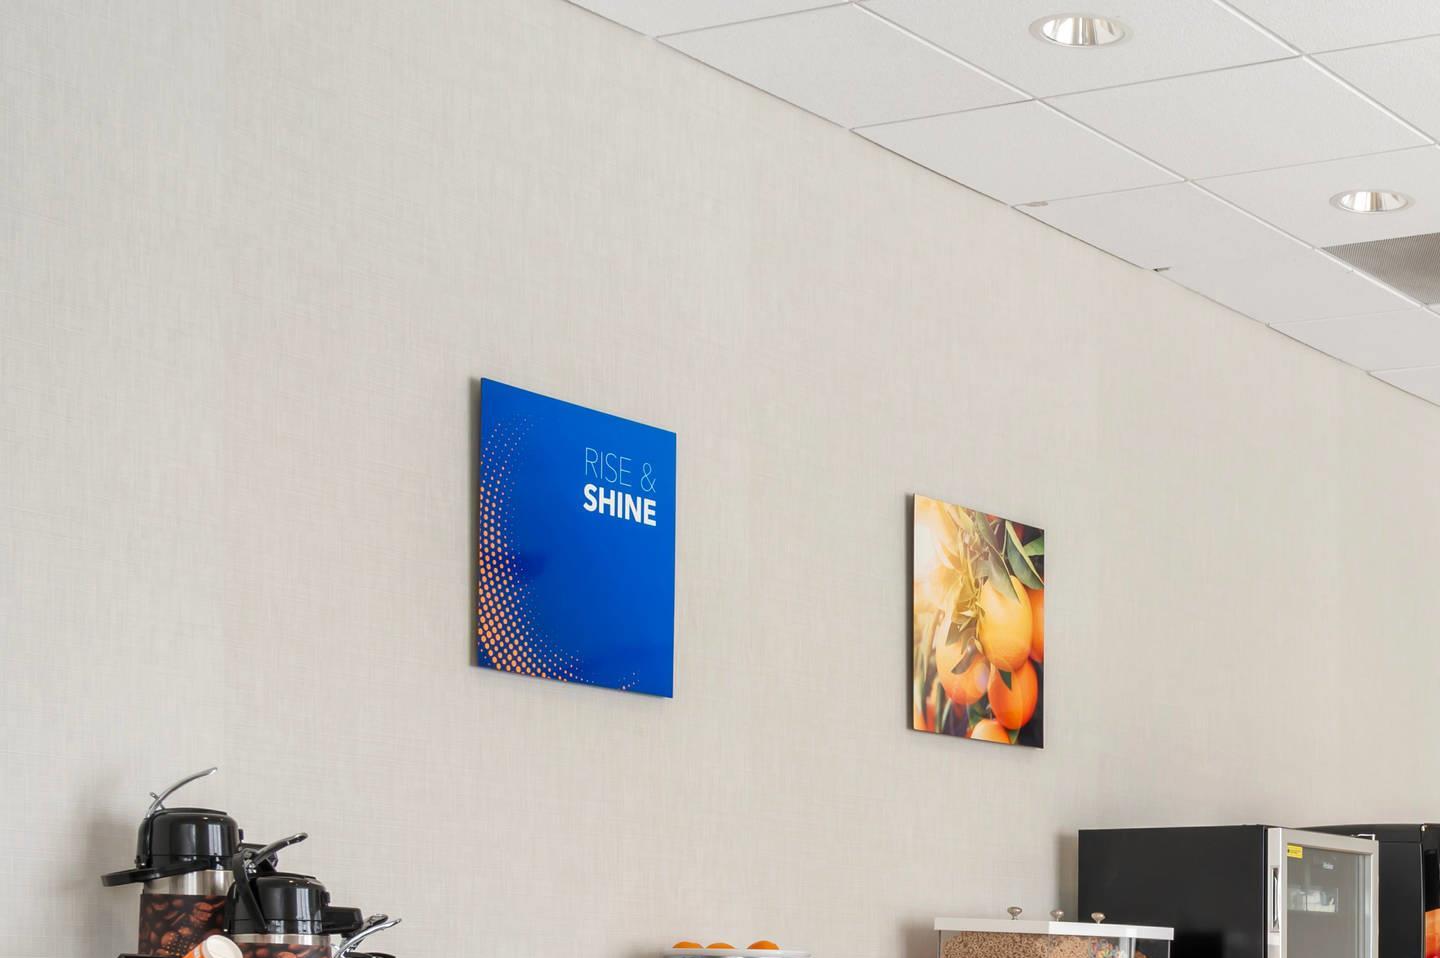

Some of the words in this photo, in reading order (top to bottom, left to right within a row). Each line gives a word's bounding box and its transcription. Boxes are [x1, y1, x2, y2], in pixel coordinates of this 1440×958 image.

[585, 447, 632, 487] RISE
[640, 462, 656, 493] &
[583, 483, 657, 527] SHINE
